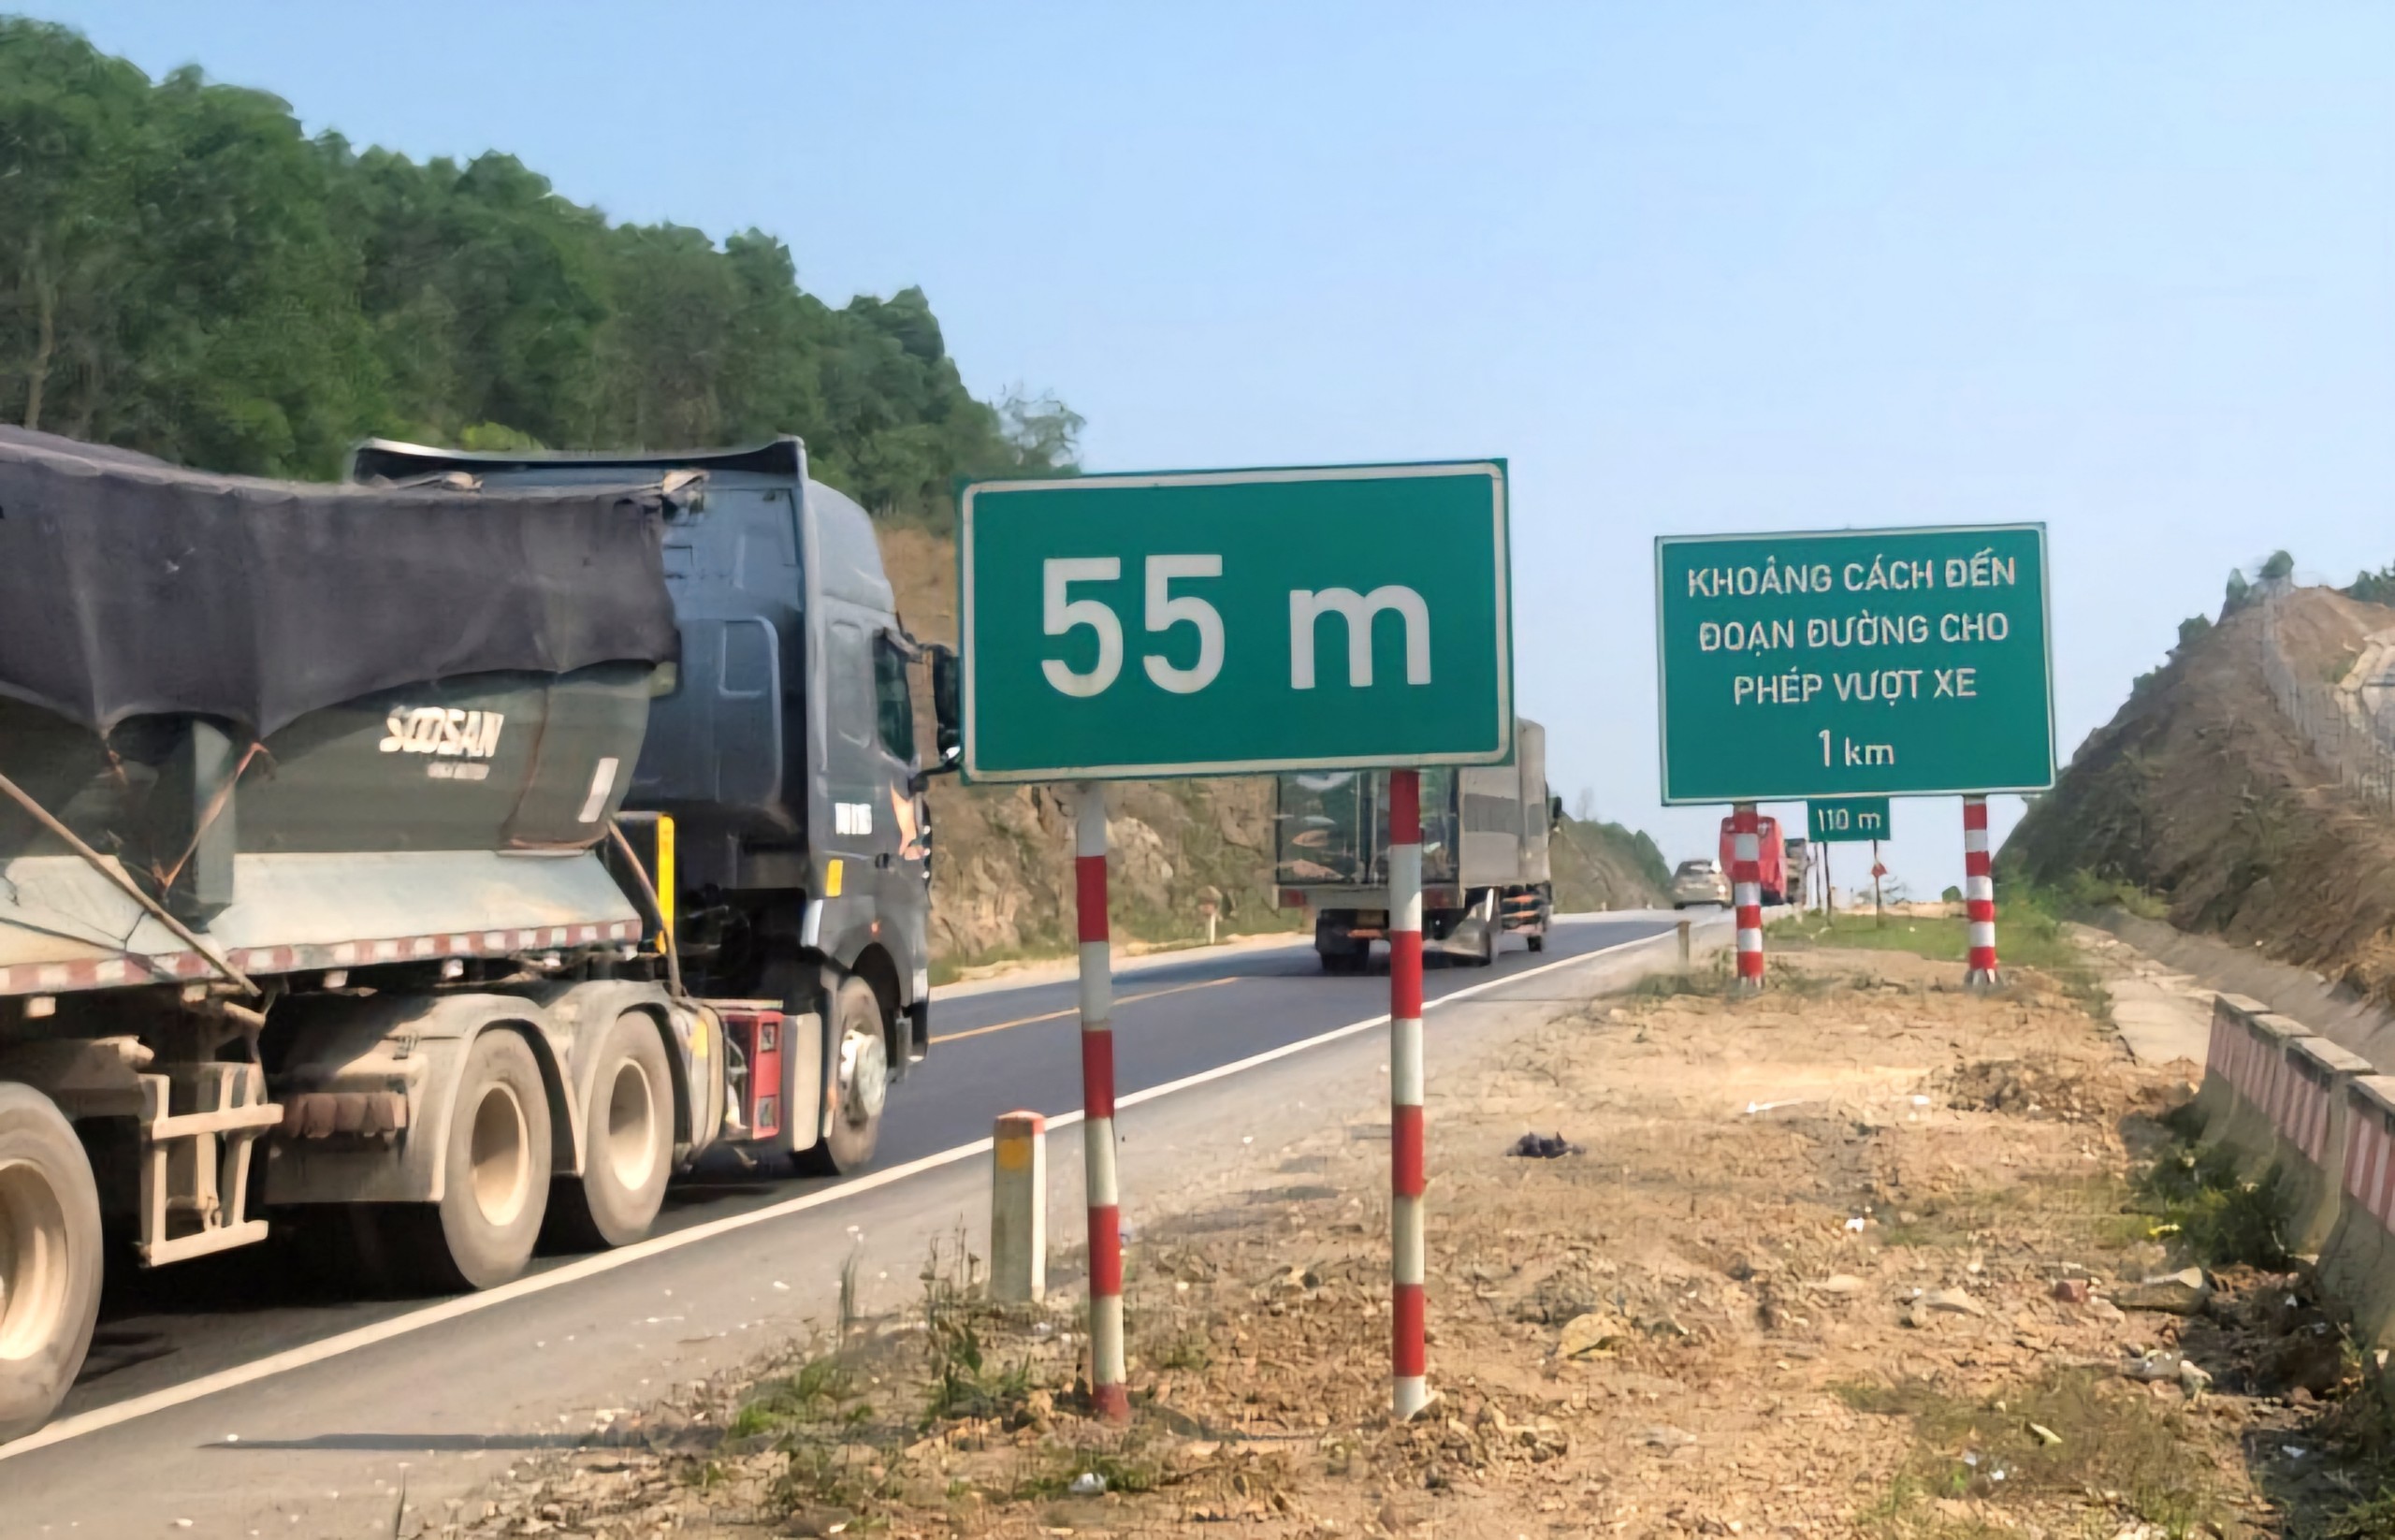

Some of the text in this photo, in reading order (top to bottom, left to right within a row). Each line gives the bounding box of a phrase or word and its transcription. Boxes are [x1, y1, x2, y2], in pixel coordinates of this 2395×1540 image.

[1688, 547, 2016, 597] KHOẢNG CÁCH ĐẾN
[1041, 554, 1432, 698] 55 m
[1699, 608, 2009, 657] ĐOẠN ĐƯỜNG CHO
[1734, 665, 1978, 707] PHÉP VƯỢT XE
[1818, 729, 1895, 768] 1 km
[1817, 807, 1882, 833] 110 m
